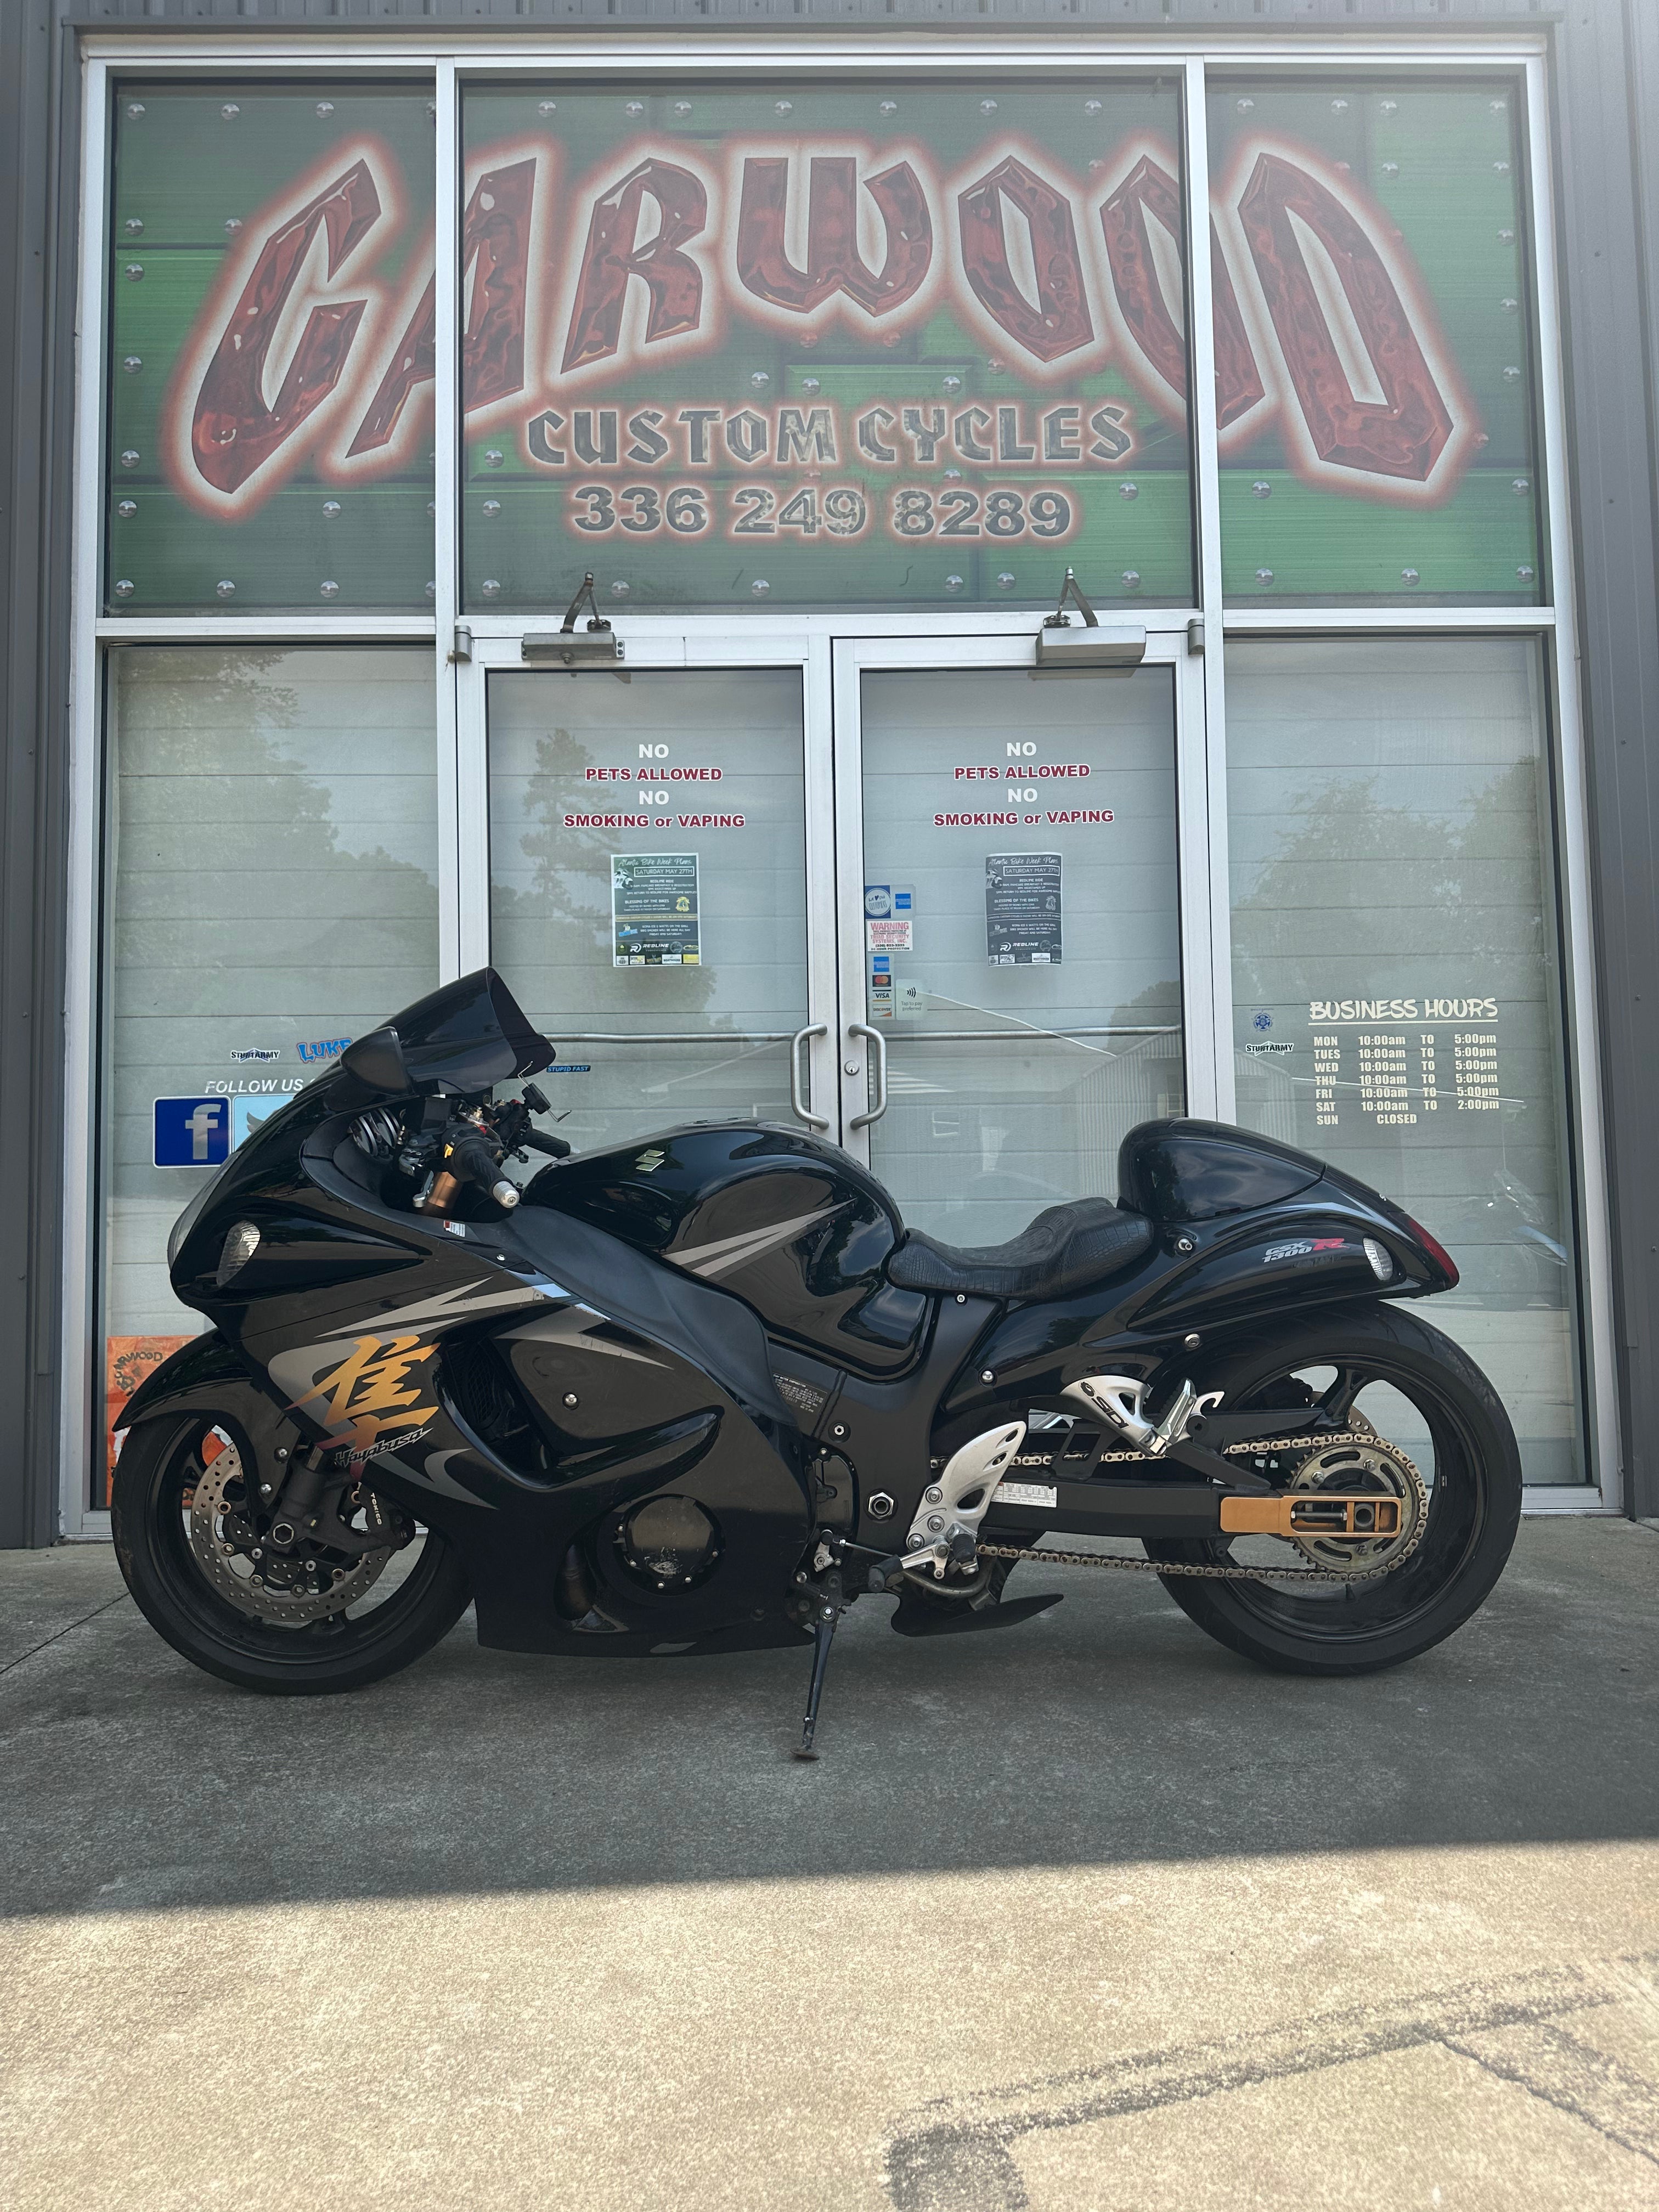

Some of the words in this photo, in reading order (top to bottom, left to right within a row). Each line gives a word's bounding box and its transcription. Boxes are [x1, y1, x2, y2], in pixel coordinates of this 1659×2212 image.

[191, 153, 1454, 493] GARWOOD
[528, 409, 837, 465] CUSTOM
[859, 407, 1131, 461] CYCLES
[574, 486, 708, 533] 336
[734, 488, 866, 535] 249
[894, 490, 1070, 537] 8289
[639, 744, 669, 758] NO
[1007, 742, 1037, 757] NO
[585, 768, 631, 781] PETS
[636, 768, 722, 781] ALLOWED
[954, 766, 999, 780] PETS
[1005, 764, 1090, 778] ALLOWED
[639, 791, 669, 805] NO
[1007, 788, 1037, 803] NO
[564, 814, 649, 827] SMOKING
[655, 817, 673, 827] or
[677, 814, 745, 827] VAPING
[934, 812, 1018, 827] SMOKING
[1024, 814, 1041, 825] or
[1046, 810, 1114, 823] VAPING
[641, 858, 654, 866] Bike
[1011, 857, 1024, 865] Bike
[1310, 999, 1418, 1020] BUSINESS
[1424, 997, 1498, 1018] HOURS
[1313, 1036, 1338, 1046] MON
[1358, 1035, 1406, 1045] 10:00am
[1420, 1034, 1434, 1044] TO
[1454, 1034, 1496, 1044] 5:00pm
[1314, 1049, 1340, 1059] TUES
[1358, 1048, 1406, 1059] 10:00am
[1420, 1047, 1434, 1057] TO
[1454, 1047, 1497, 1057] 5:00pm
[1314, 1062, 1339, 1072] WED
[1359, 1062, 1407, 1071] 10:00am
[1421, 1060, 1435, 1070] TO
[1455, 1060, 1497, 1070] 5:00pm
[204, 1079, 278, 1093] FOLLOW
[281, 1079, 303, 1092] US
[1314, 1075, 1336, 1085] THU
[1359, 1075, 1407, 1085] 10:00am
[1421, 1074, 1435, 1084] TO
[1455, 1073, 1498, 1084] 5:00pm
[1316, 1089, 1333, 1098] FRI
[1360, 1088, 1408, 1098] 10:00am
[1423, 1087, 1436, 1097] TO
[1457, 1086, 1499, 1097] 5:00pm
[1316, 1102, 1336, 1111] SAT
[1361, 1101, 1408, 1111] 10:00am
[1423, 1100, 1437, 1110] TO
[1458, 1099, 1499, 1110] 2:00pm
[1317, 1115, 1339, 1125] SUN
[1376, 1114, 1417, 1124] CLOSED
[1262, 1246, 1313, 1263] 1300
[1266, 1241, 1310, 1255] GSX
[335, 1427, 434, 1468] Hayabusa
[370, 1492, 382, 1525] TOKICO
